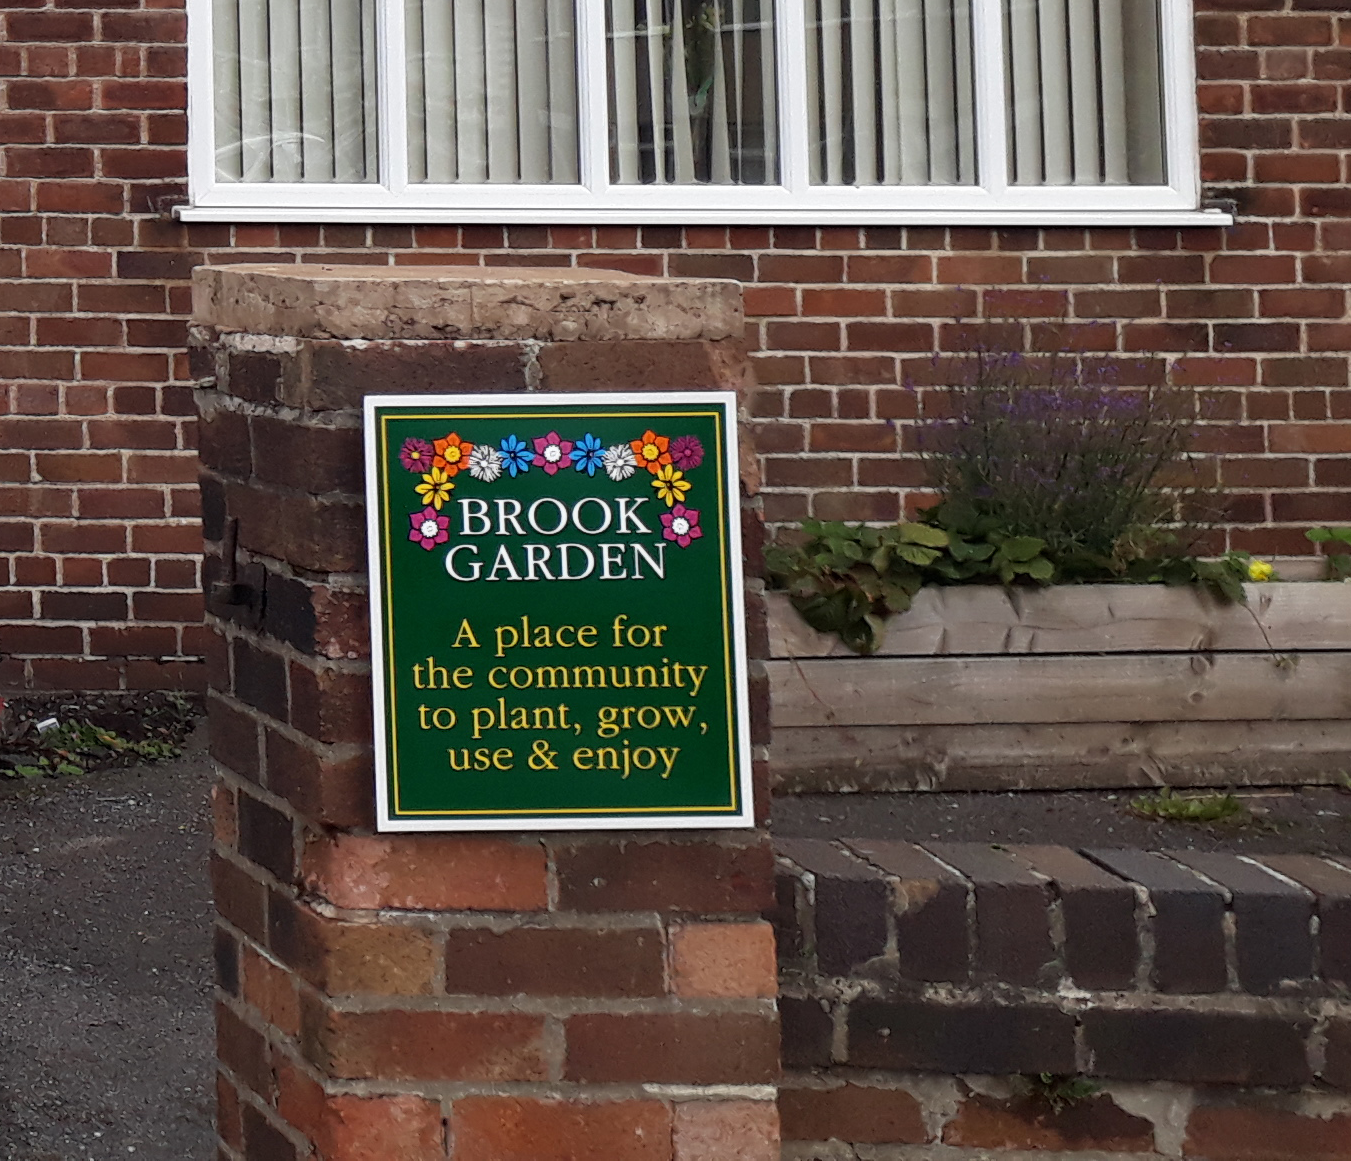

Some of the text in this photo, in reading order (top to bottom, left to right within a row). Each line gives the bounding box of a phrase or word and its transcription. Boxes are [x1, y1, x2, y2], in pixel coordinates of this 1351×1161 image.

[457, 497, 652, 536] BROOK
[445, 542, 667, 581] GARDEN
[451, 614, 668, 657] A place for
[412, 657, 709, 696] the community
[418, 698, 709, 739] to plant, grow,
[447, 740, 680, 779] use & enjoy
